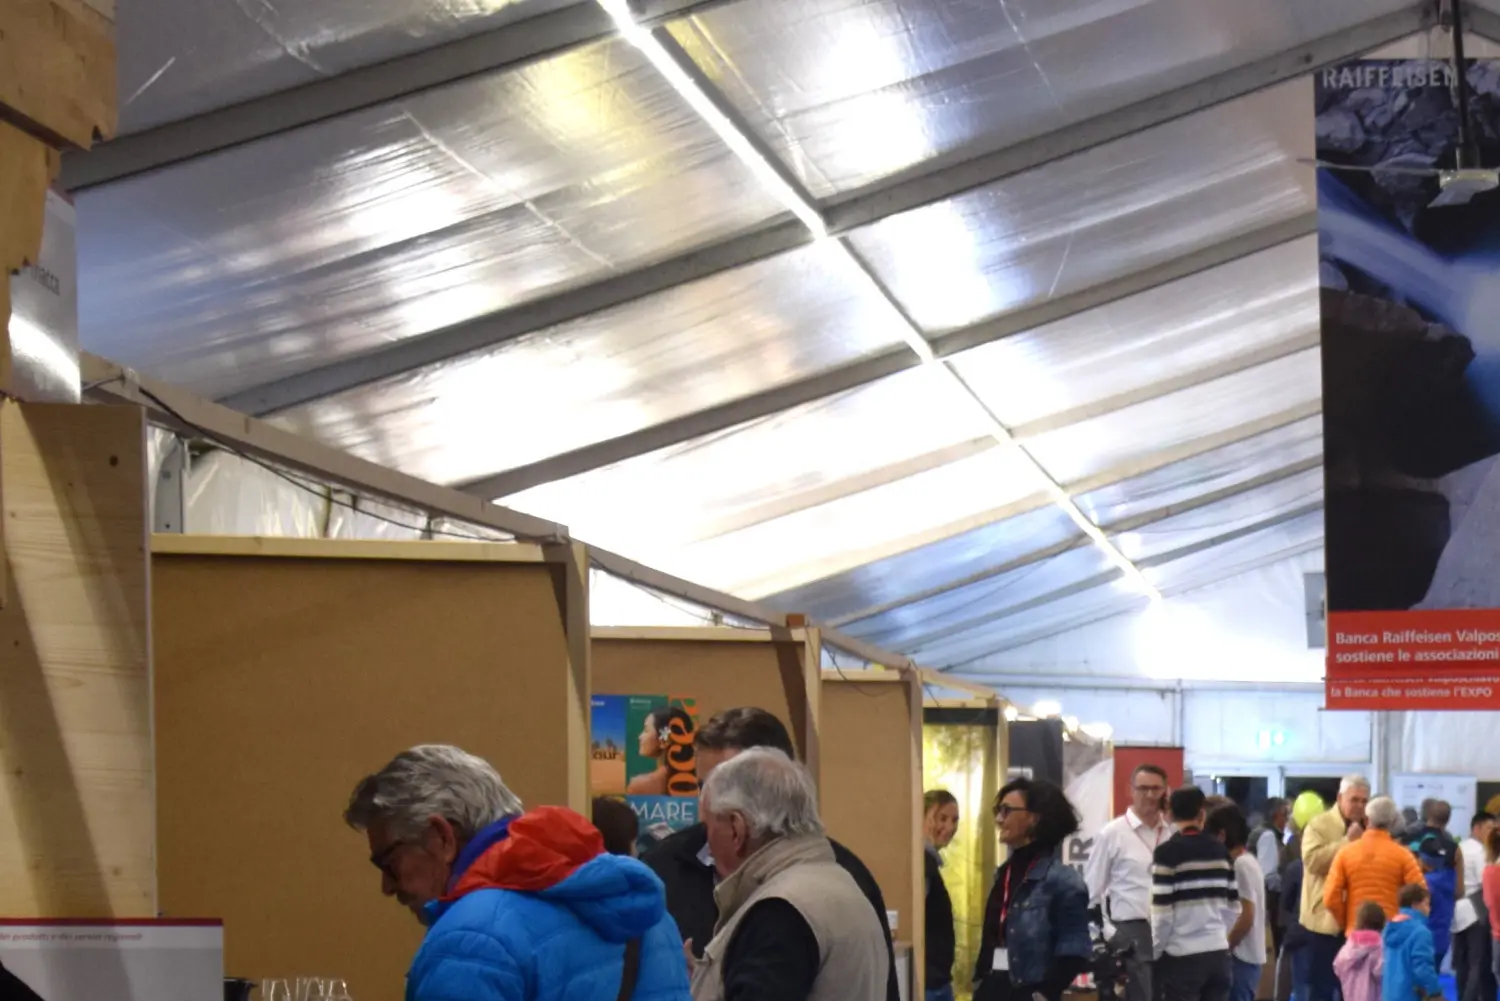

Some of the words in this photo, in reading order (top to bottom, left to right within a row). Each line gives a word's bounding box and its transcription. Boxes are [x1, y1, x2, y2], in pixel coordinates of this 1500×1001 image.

[1322, 66, 1459, 89] RAIFFEISEN
[1336, 632, 1378, 645] Banca
[1382, 630, 1452, 644] Raiffeisen
[1336, 650, 1393, 664] sostiene
[1398, 650, 1411, 662] le
[1415, 649, 1499, 662] associazioni
[1331, 687, 1341, 697] la
[1345, 687, 1378, 698] Banca
[1382, 687, 1401, 697] che
[1405, 687, 1450, 698] sostiene
